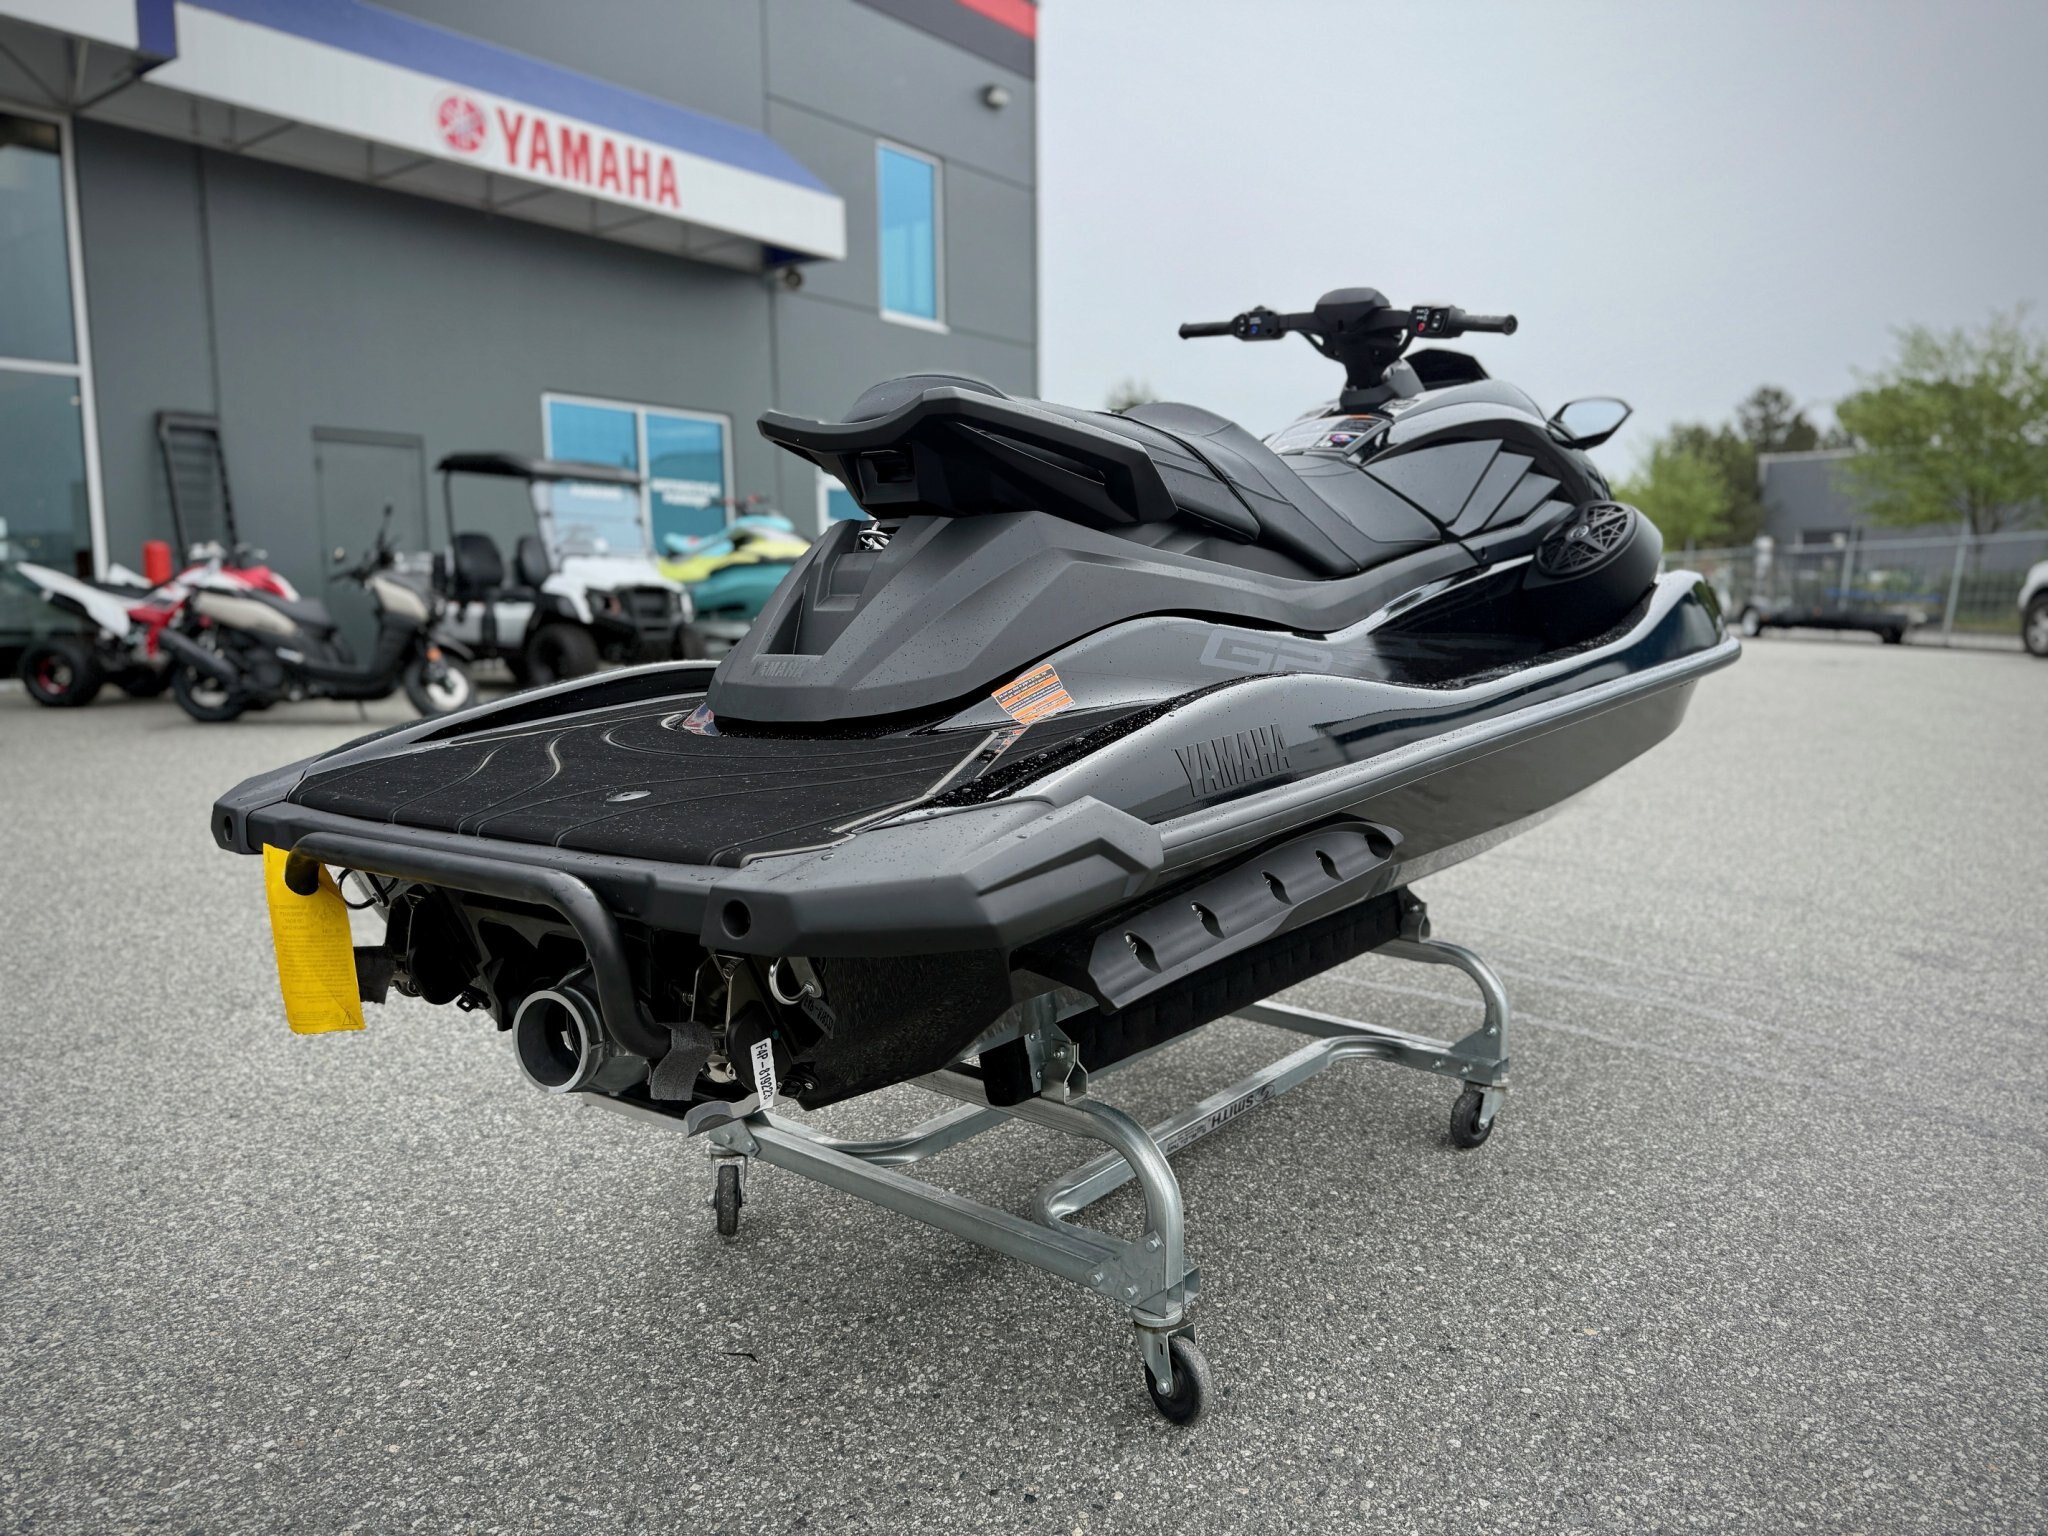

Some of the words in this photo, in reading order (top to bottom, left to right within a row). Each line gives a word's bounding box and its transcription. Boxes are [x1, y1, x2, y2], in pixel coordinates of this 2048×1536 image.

[497, 105, 682, 209] YAMAHA
[752, 660, 805, 679] YAMAHA
[1200, 628, 1334, 673] GP
[1174, 722, 1290, 798] YAMAHA
[755, 1042, 774, 1101] F4P-819223
[1211, 1094, 1254, 1129] SMITH
